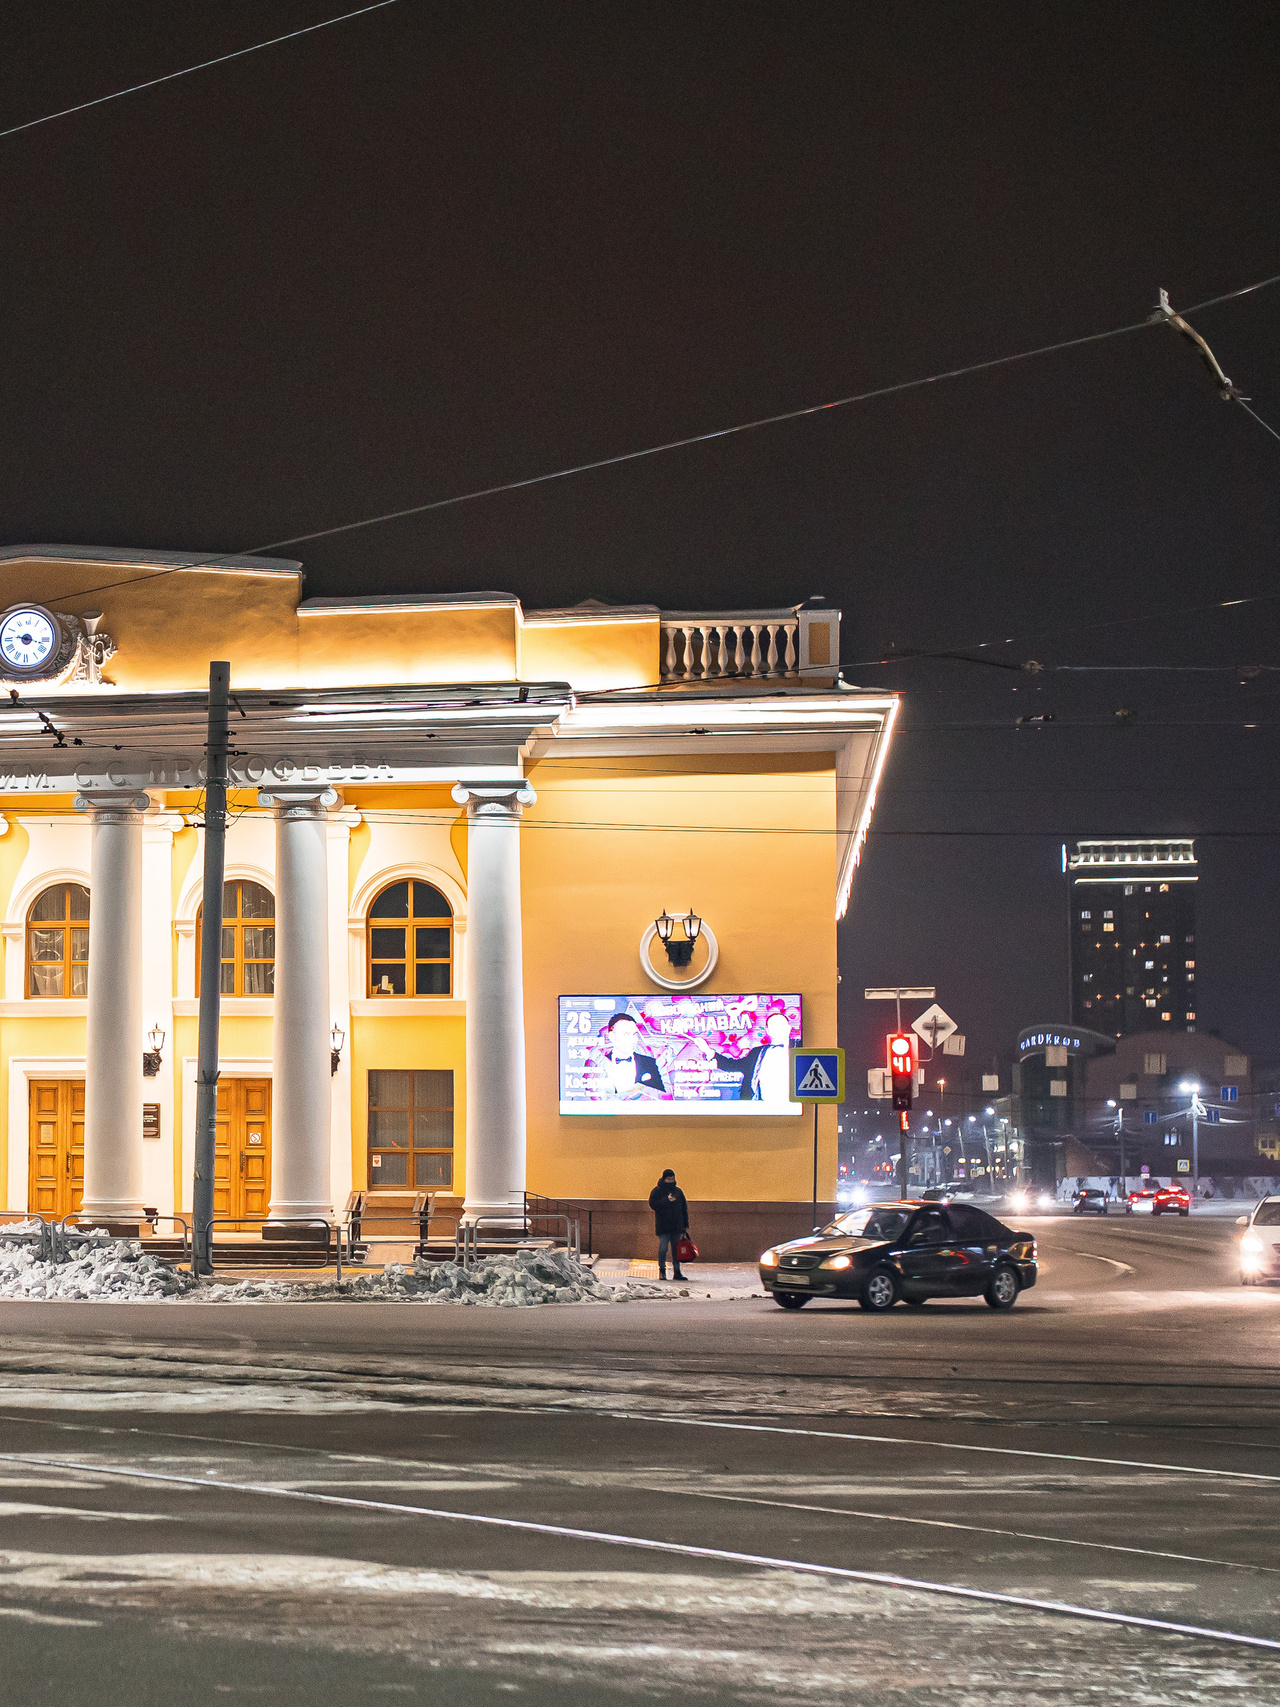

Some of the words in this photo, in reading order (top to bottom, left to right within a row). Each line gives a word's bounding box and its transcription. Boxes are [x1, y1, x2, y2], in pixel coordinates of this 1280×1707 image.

[566, 1011, 592, 1034] 26
[660, 1013, 753, 1035] КАРНАВАЛ
[893, 1056, 911, 1073] 41
